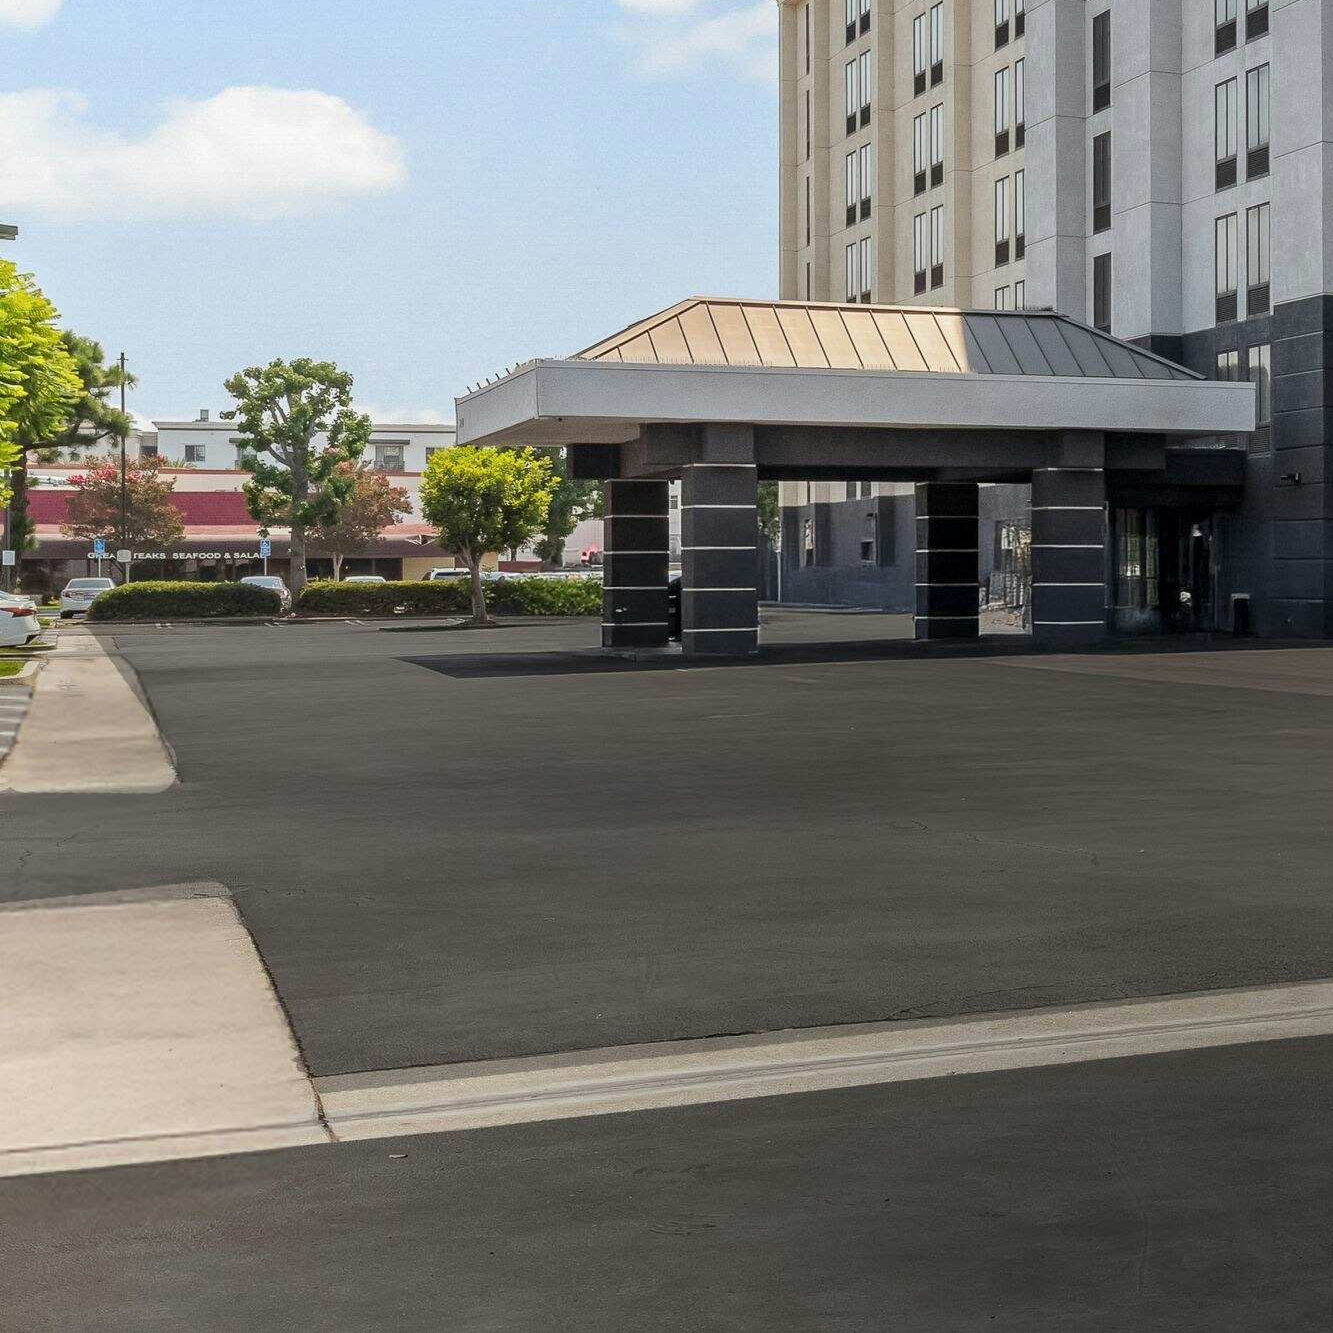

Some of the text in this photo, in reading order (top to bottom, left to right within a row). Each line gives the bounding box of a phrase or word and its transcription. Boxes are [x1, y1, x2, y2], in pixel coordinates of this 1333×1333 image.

[133, 552, 167, 560] TEAKS
[172, 552, 222, 560] SEAFOOD
[223, 552, 232, 560] &
